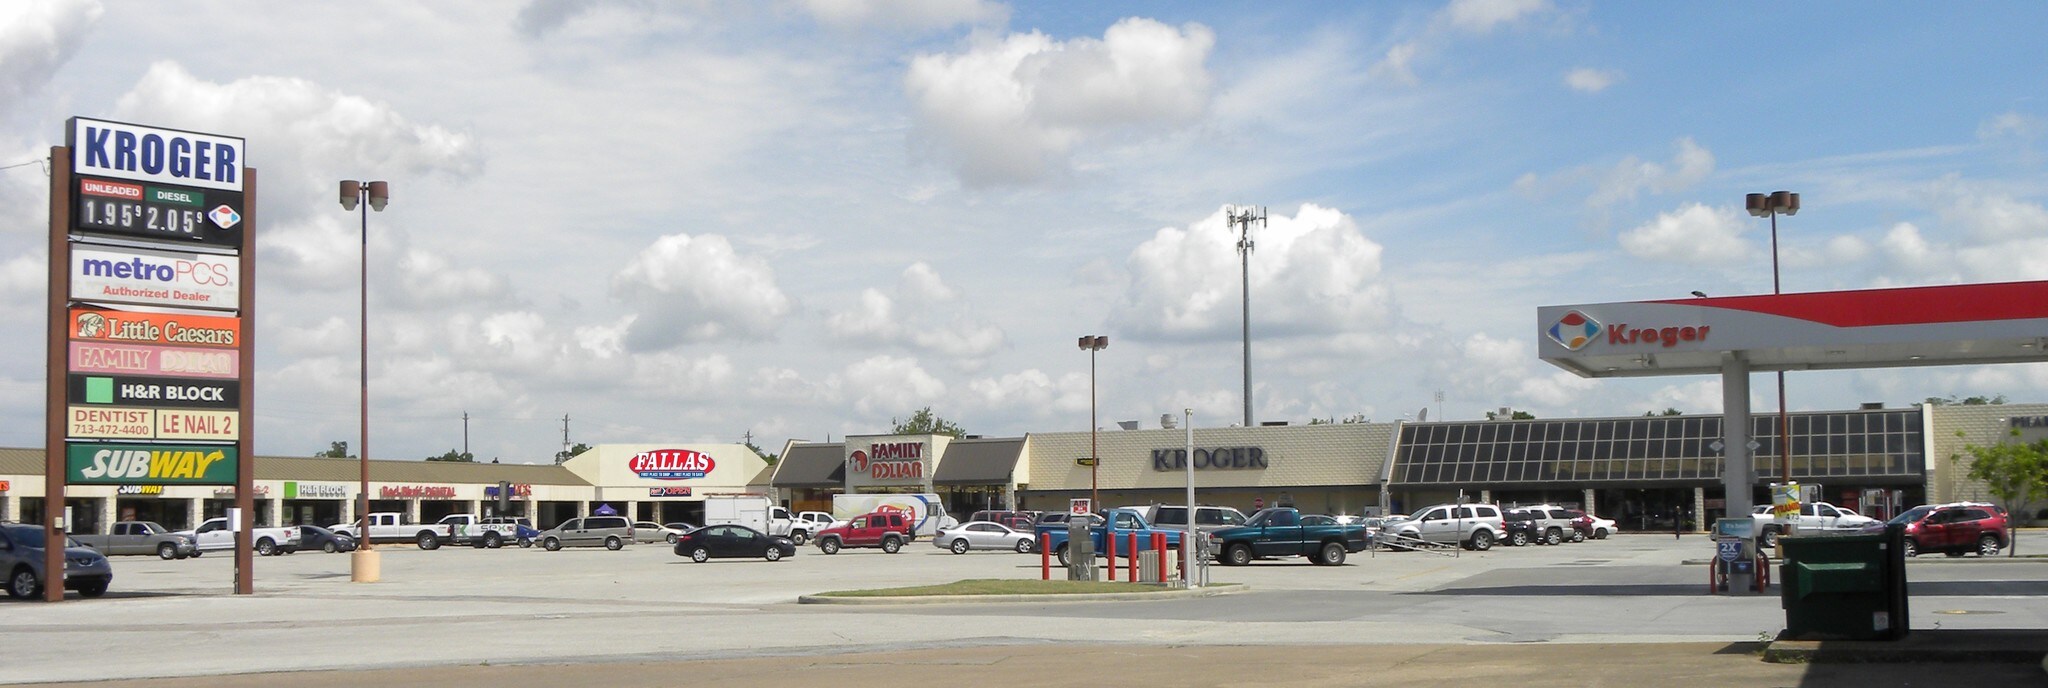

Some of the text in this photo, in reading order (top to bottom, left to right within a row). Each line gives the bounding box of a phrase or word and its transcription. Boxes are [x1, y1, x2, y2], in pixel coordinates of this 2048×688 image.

[85, 126, 236, 184] KROGER
[84, 183, 140, 197] UNLEADED
[157, 190, 192, 203] DIESEL
[83, 257, 229, 287] metroPCS
[103, 285, 210, 301] Authorized Dealer
[108, 318, 234, 345] Little Caesars
[1608, 323, 1710, 348] Kroger
[78, 346, 152, 370] FAMILY
[121, 384, 224, 402] H&R BLOCK
[75, 409, 148, 423] DENTIST
[163, 414, 232, 435] LE NAIL 2
[74, 425, 149, 435] 713-472-4400
[871, 442, 923, 459] FAMILY
[1153, 447, 1267, 470] KROGER
[81, 449, 225, 479] SUBWAY
[635, 452, 710, 471] FALLAS
[871, 461, 923, 479] DOLLAR
[118, 485, 163, 494] SUBWAY
[425, 486, 457, 498] DENTAL
[1720, 543, 1736, 552] 2X
